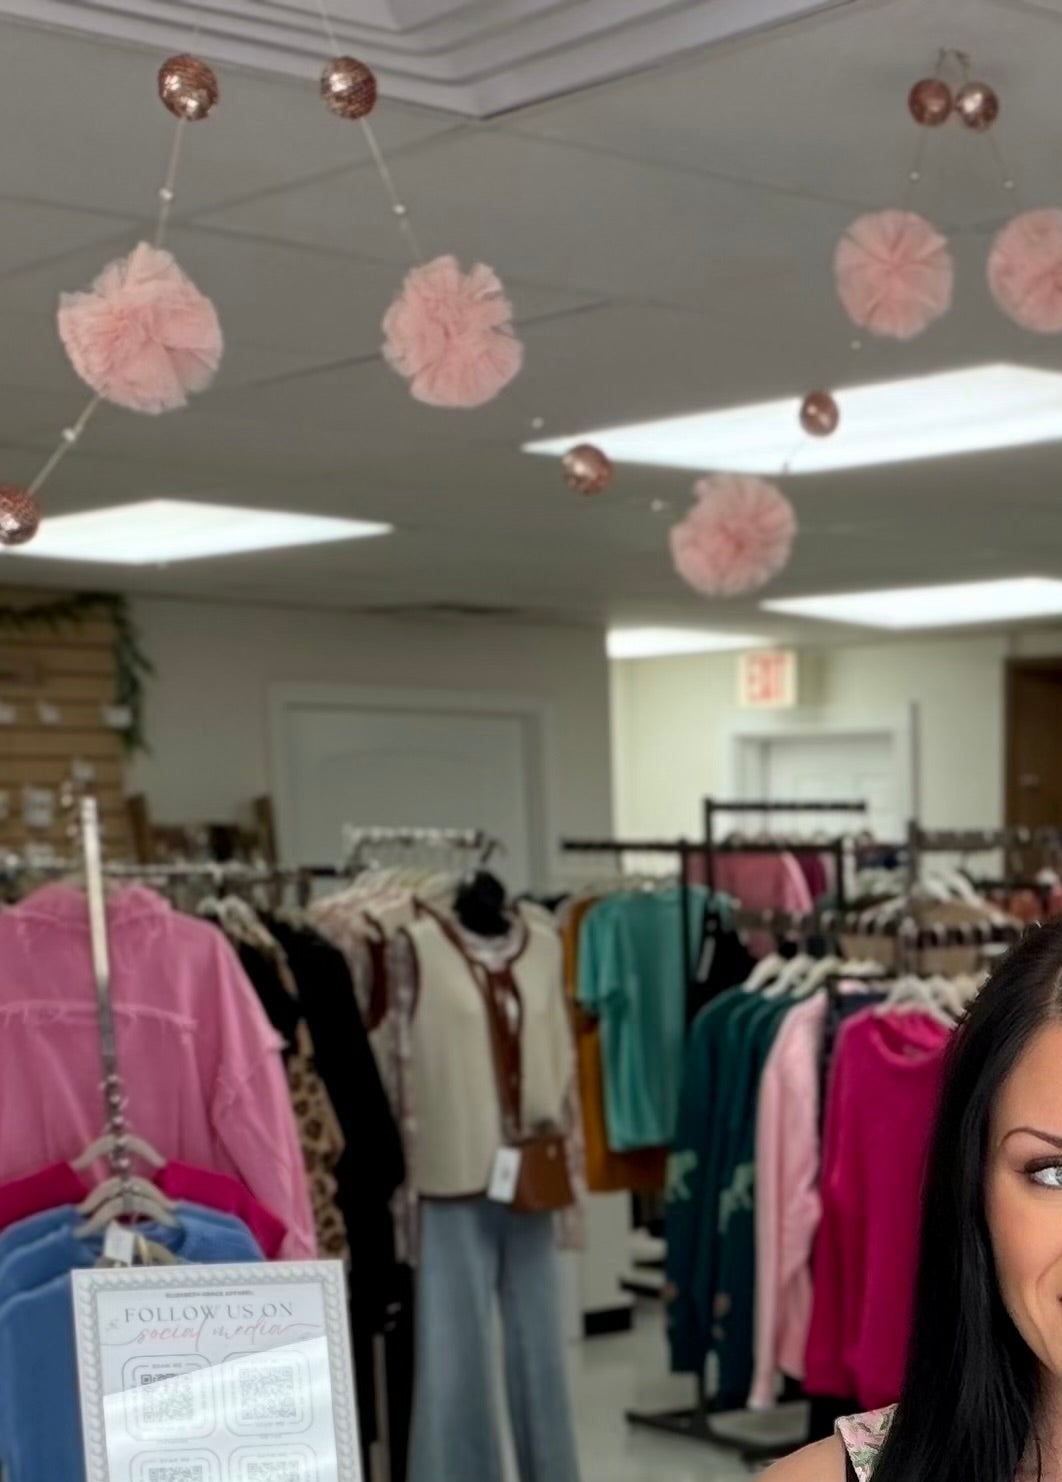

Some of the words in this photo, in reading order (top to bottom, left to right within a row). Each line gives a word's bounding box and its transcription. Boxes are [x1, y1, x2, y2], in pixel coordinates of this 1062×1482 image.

[125, 1303, 216, 1323] FOLLOW
[227, 1303, 254, 1319] US
[262, 1302, 294, 1318] ON
[134, 1313, 208, 1352] social
[212, 1314, 298, 1345] media
